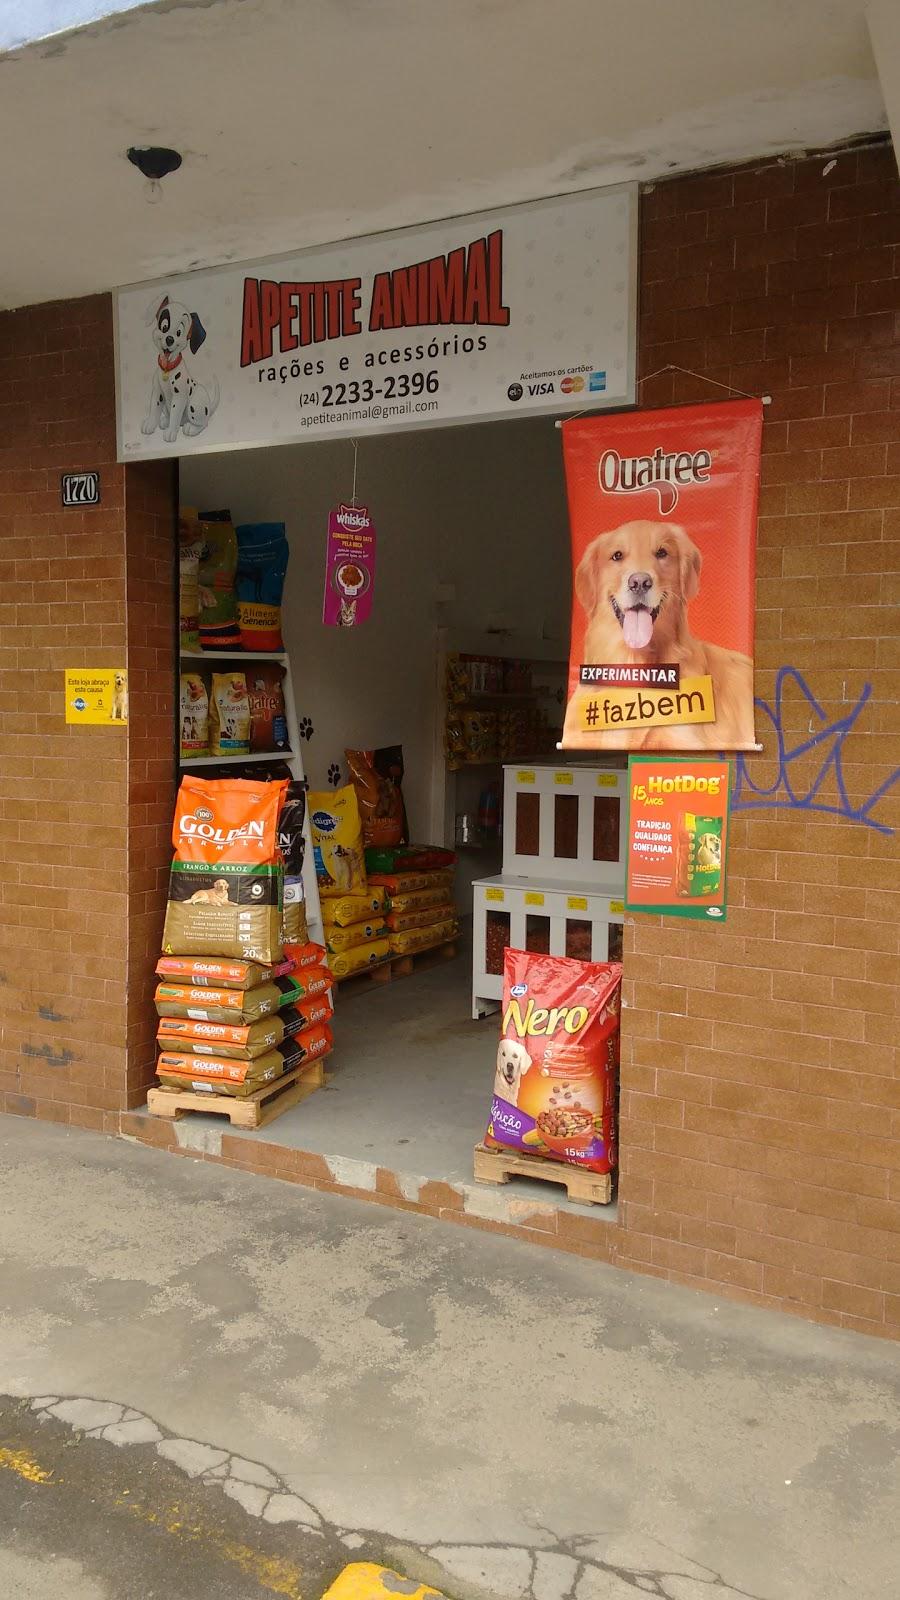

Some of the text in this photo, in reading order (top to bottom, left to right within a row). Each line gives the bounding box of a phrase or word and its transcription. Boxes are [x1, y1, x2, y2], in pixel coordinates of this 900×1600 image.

[239, 229, 511, 368] APETITE ANIMAL
[258, 333, 488, 384] rações e acessórios
[520, 371, 556, 381] Aceitamos
[567, 365, 594, 375] cartões
[299, 370, 440, 407] (24) 2233-2396
[528, 383, 555, 396] VISA
[301, 399, 440, 427] apetiteanimal@gmail.com
[66, 476, 97, 502] 1770
[599, 446, 712, 512] Quatree
[581, 667, 677, 682] EXPERIMENTAR
[585, 689, 706, 725] #fazbem
[633, 785, 647, 800] 15
[648, 775, 721, 796] HotDog
[634, 831, 672, 842] QUALIDADE
[636, 820, 671, 831] TRADIÇÃO
[633, 842, 672, 854] CONFIANÇA
[502, 999, 590, 1037] Nero
